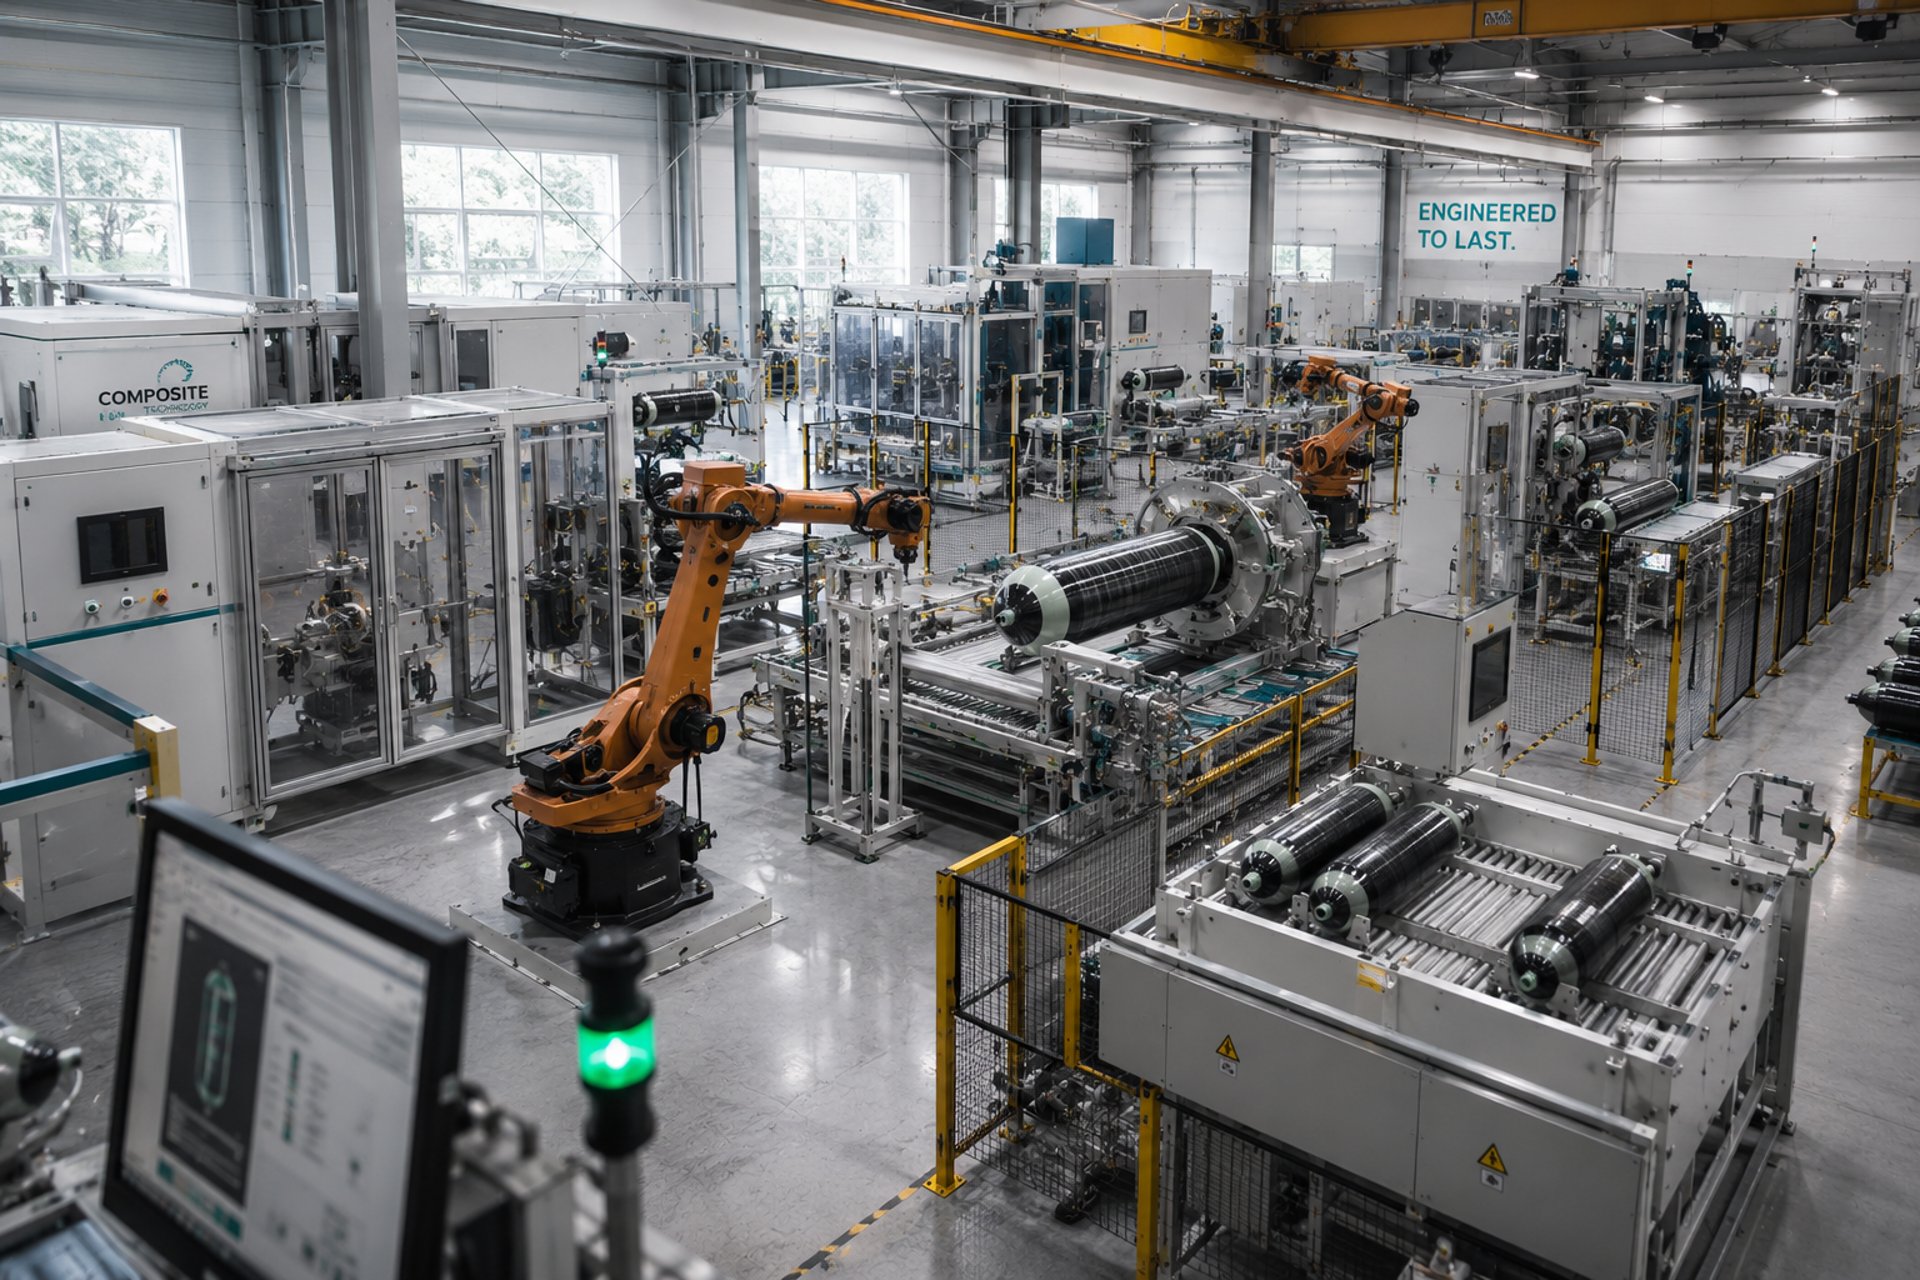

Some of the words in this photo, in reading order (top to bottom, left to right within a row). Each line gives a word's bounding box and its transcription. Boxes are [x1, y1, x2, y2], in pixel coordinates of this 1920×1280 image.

[1418, 202, 1556, 222] ENGINEERED
[1418, 229, 1447, 249] TO
[1455, 230, 1515, 250] LAST.
[98, 385, 208, 405] COMPOSITE
